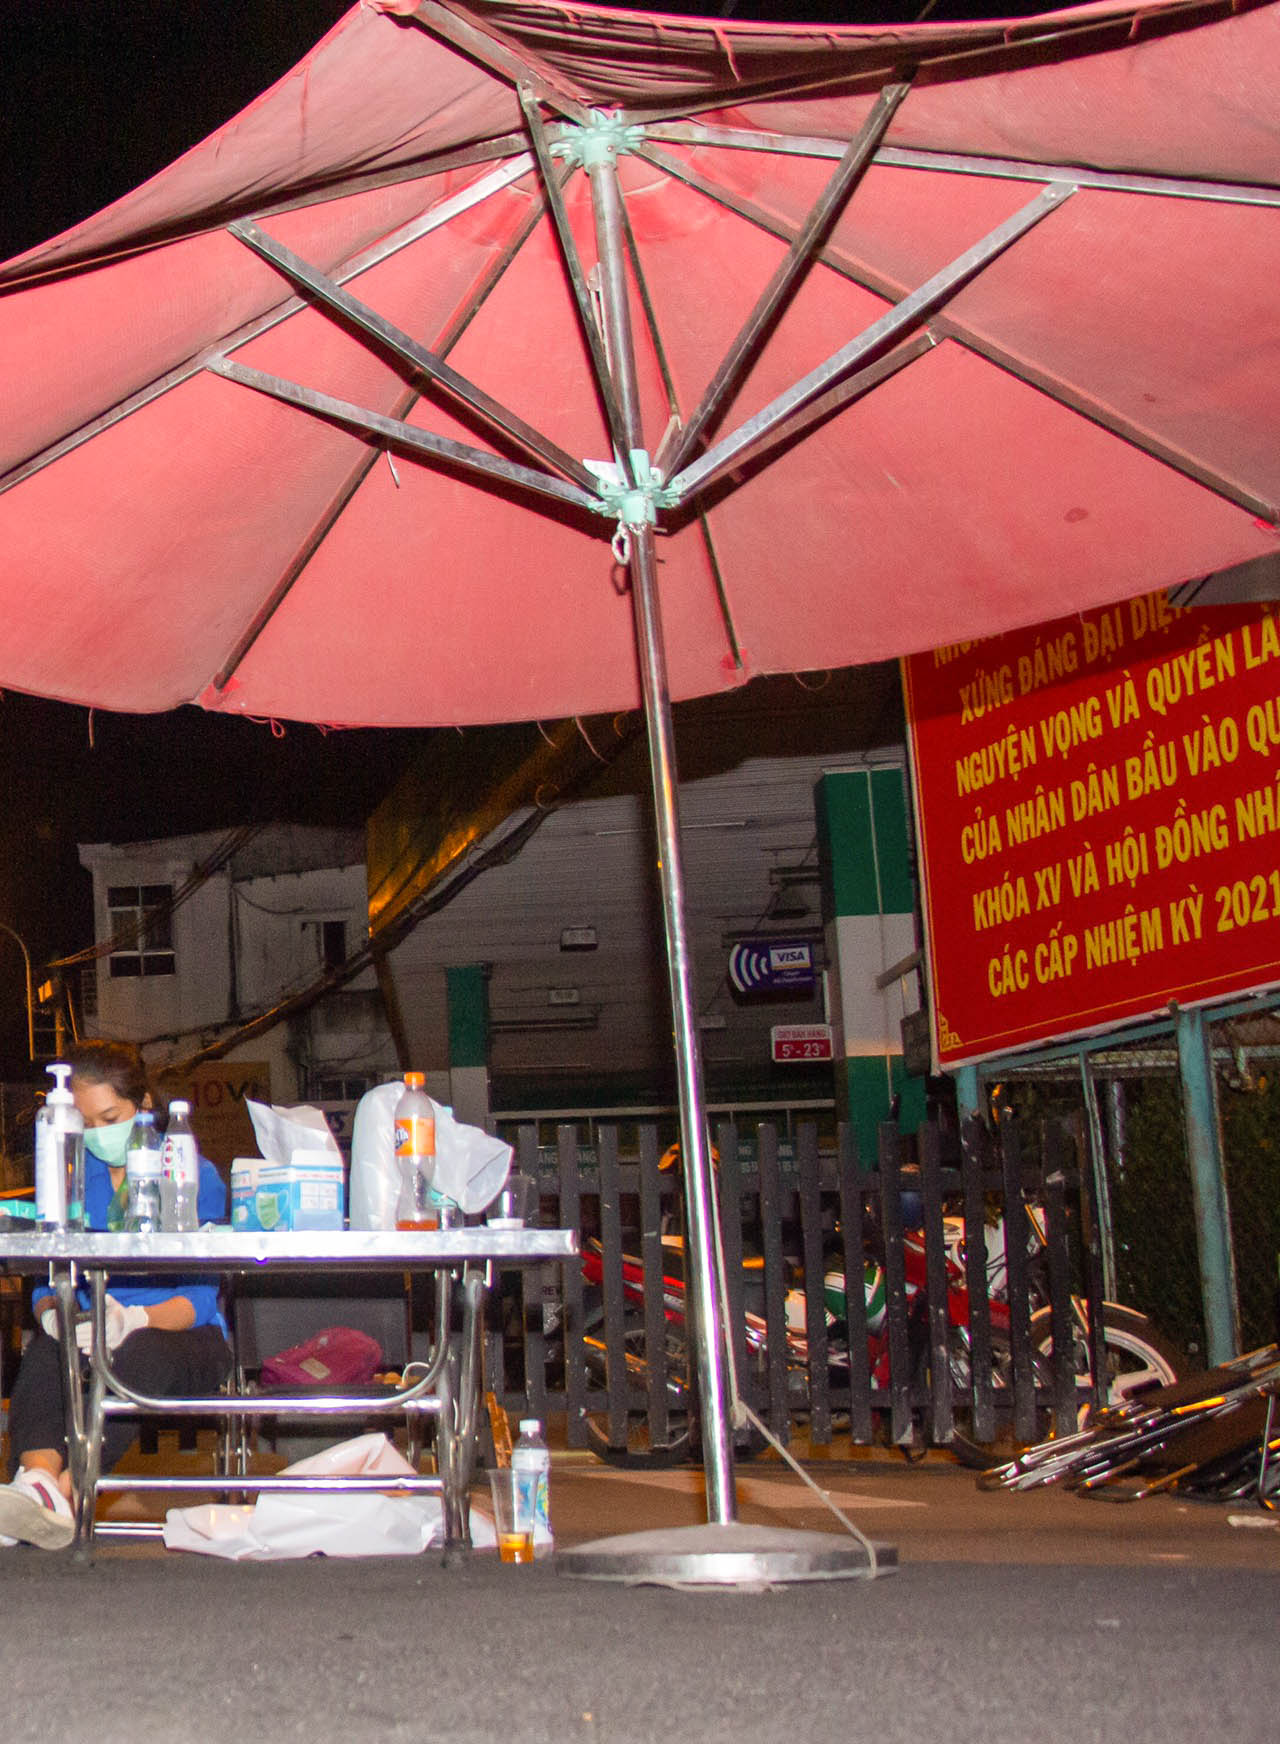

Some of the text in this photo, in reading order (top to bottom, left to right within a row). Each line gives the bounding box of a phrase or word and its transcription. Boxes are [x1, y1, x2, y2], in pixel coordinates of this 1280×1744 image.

[1017, 632, 1078, 697] ĐÁNG
[1081, 606, 1124, 664] ĐẠI
[1129, 589, 1192, 641] DIỆ
[956, 724, 1037, 797] NGUYỆN
[1040, 696, 1103, 761] VỌNG
[1106, 670, 1140, 729] VÀ
[1146, 625, 1236, 716] QUYỀN
[961, 806, 1003, 865] CỦA
[1006, 785, 1066, 847] NHÂN
[1070, 762, 1120, 822] DÂN
[1125, 730, 1177, 801] BẦU
[1183, 714, 1239, 777] VÀO
[973, 871, 1031, 931] KHÓA
[1035, 863, 1061, 911] XV
[1068, 841, 1100, 897] VÀ
[1105, 826, 1149, 888] HỘI
[1155, 799, 1229, 869] ĐỒNG
[776, 951, 805, 962] VISA
[988, 943, 1030, 997] CÁC
[1034, 921, 1078, 984] CẤP
[1084, 903, 1164, 970] NHIỆM
[1169, 884, 1204, 945] KỲ
